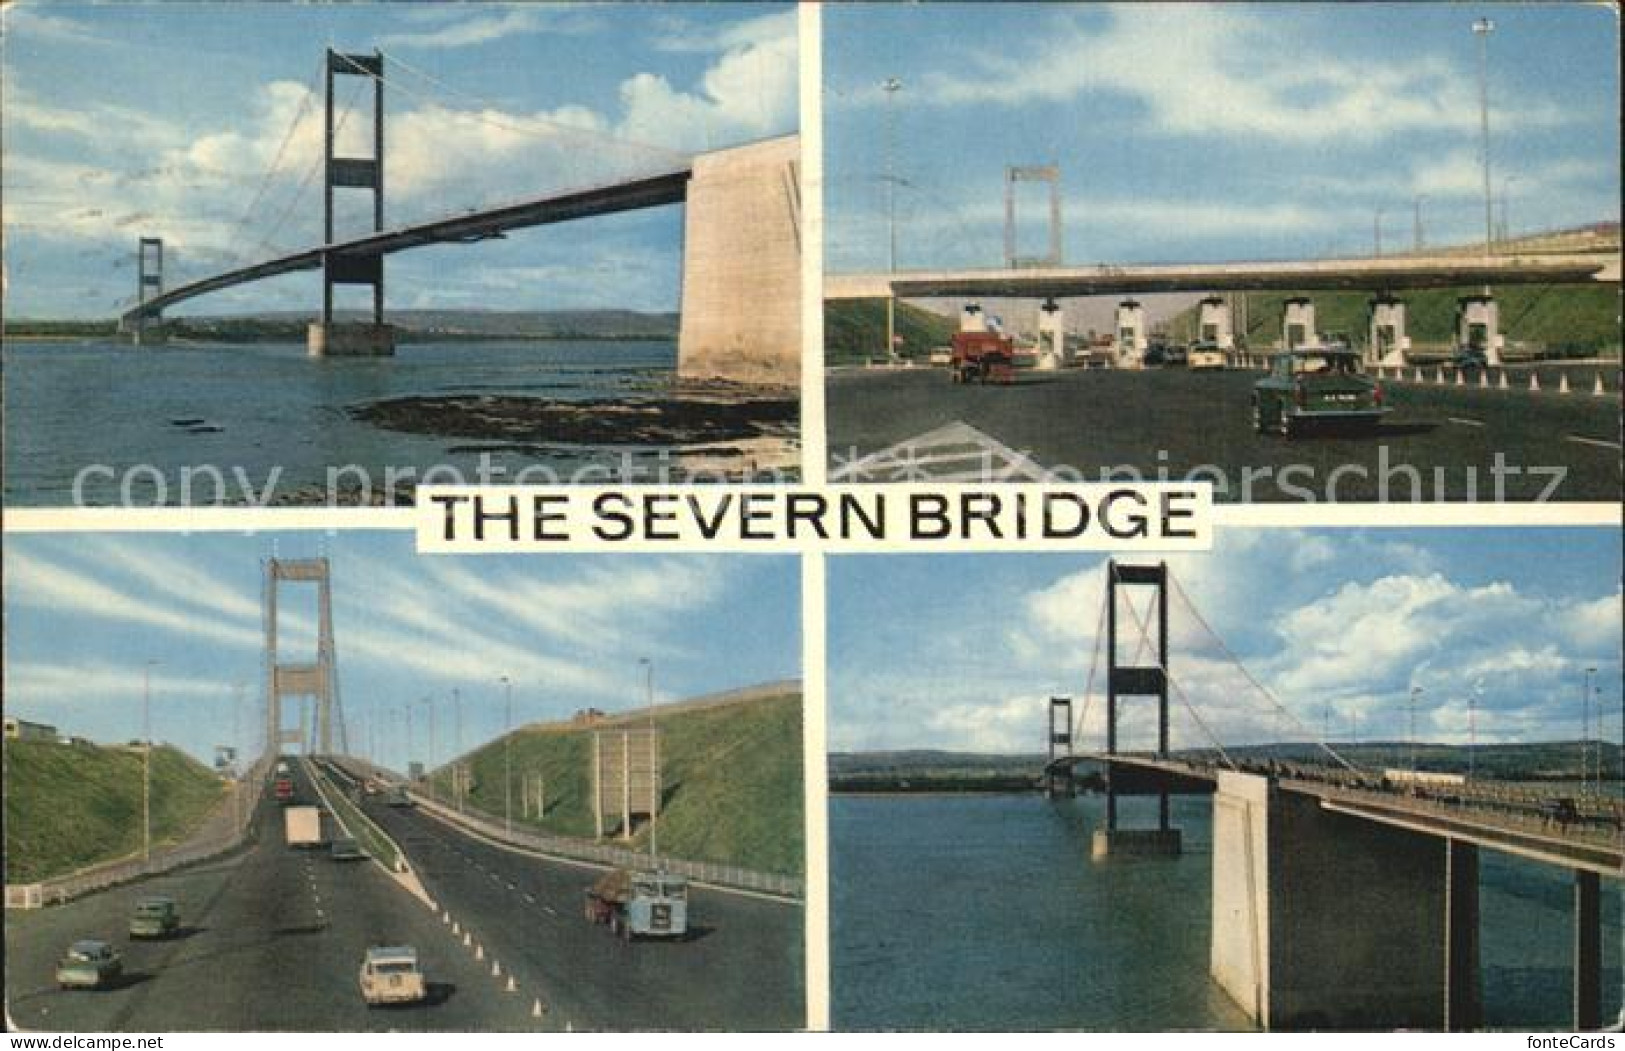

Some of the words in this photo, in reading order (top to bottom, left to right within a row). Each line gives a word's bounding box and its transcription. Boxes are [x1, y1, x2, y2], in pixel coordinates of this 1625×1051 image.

[430, 494, 570, 541] THE
[591, 491, 885, 541] SEVERN
[909, 489, 1197, 539] BRIDGE
